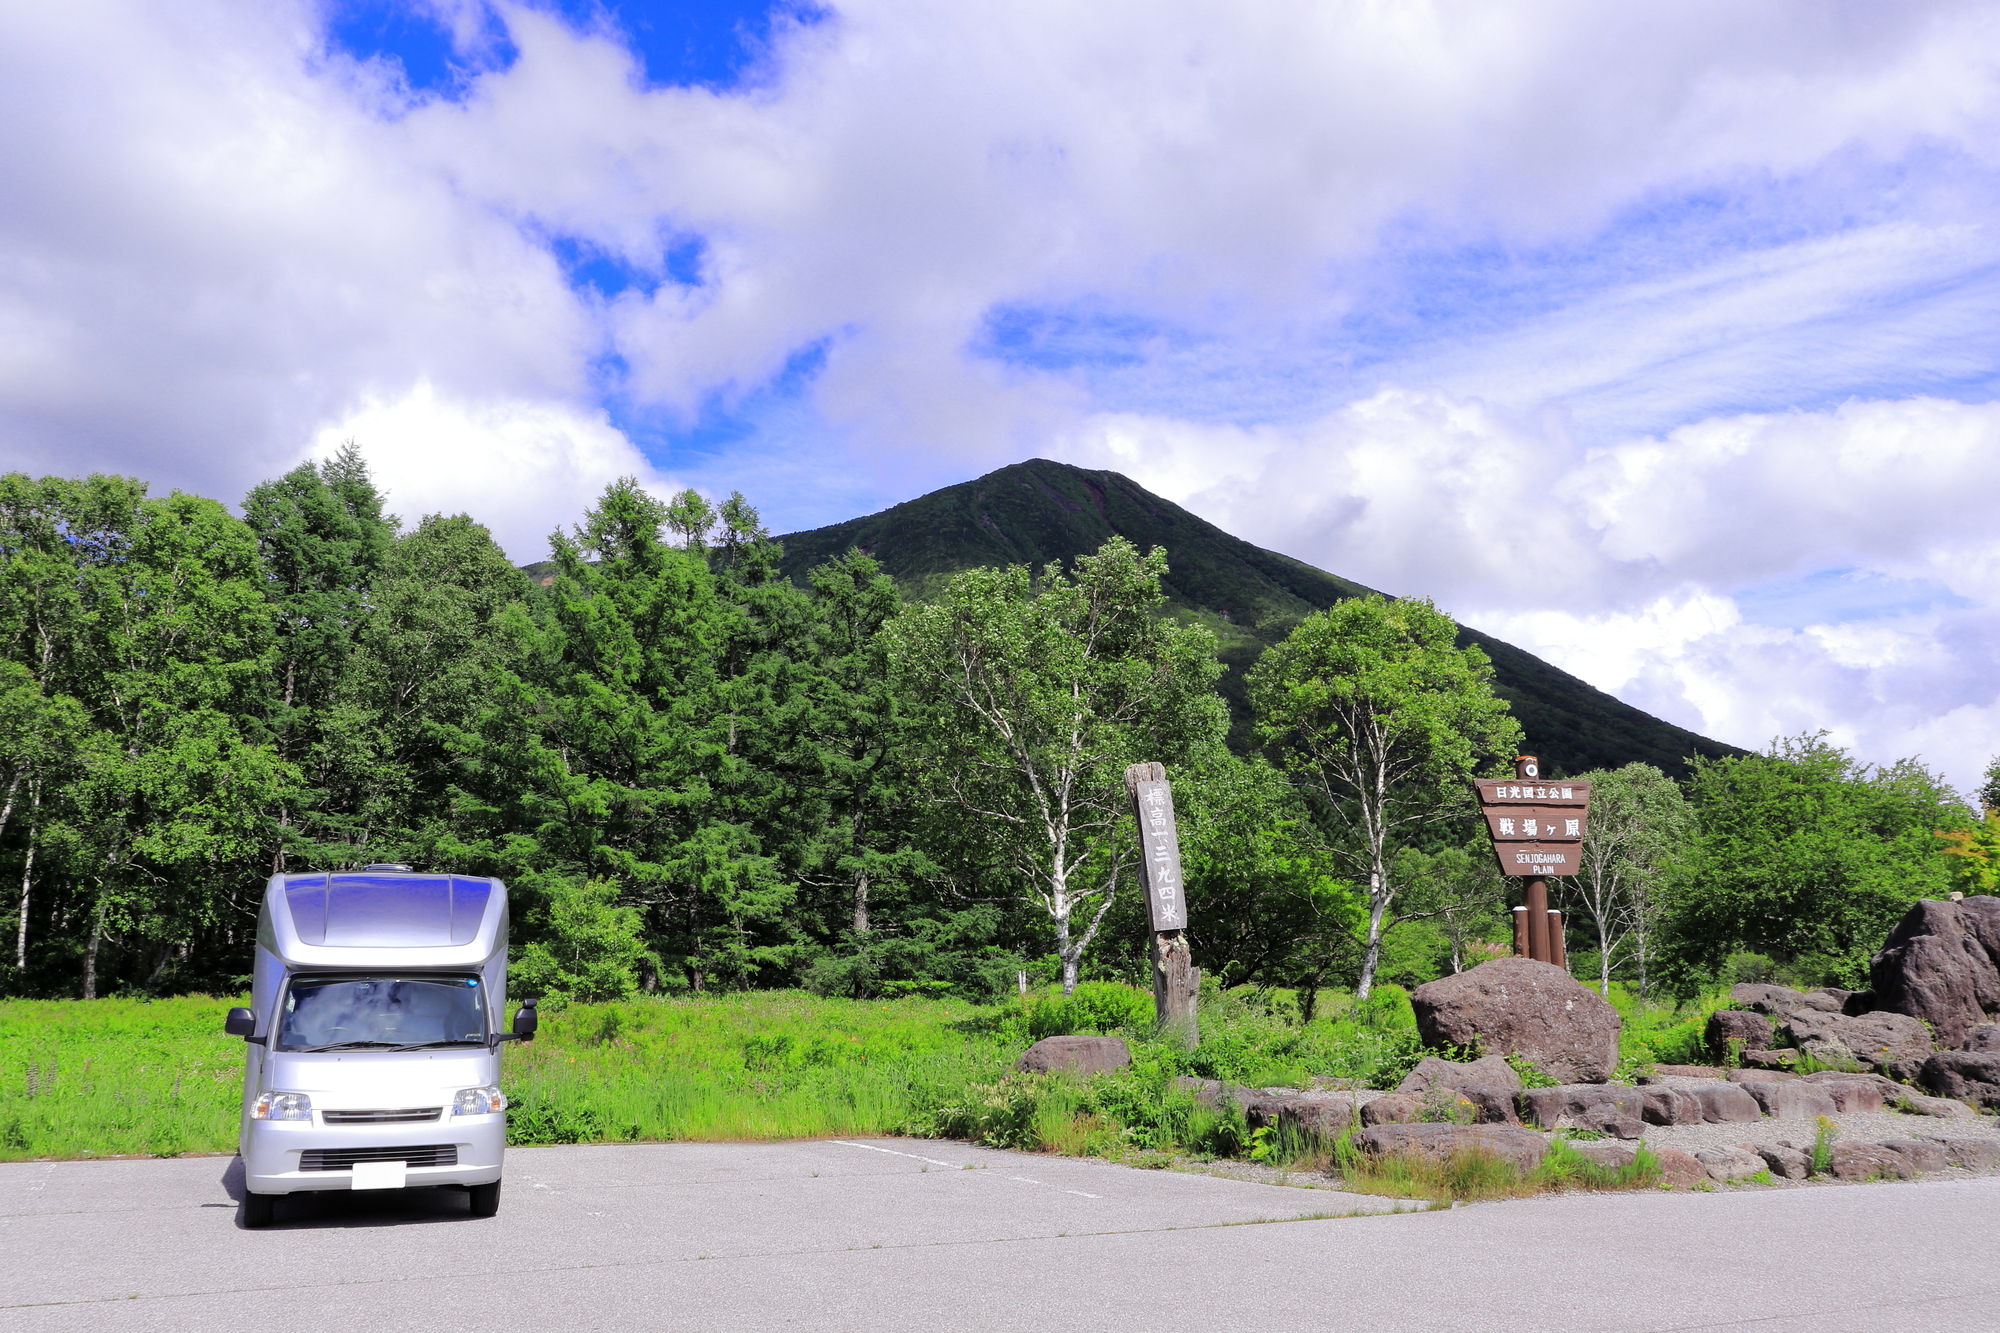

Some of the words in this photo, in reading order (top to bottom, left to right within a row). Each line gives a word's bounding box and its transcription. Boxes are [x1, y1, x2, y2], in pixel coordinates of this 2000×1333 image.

[1496, 786, 1573, 799] 日光国立公園
[1515, 853, 1566, 864] SENJOGAHARA
[1532, 865, 1555, 874] PLAIN
